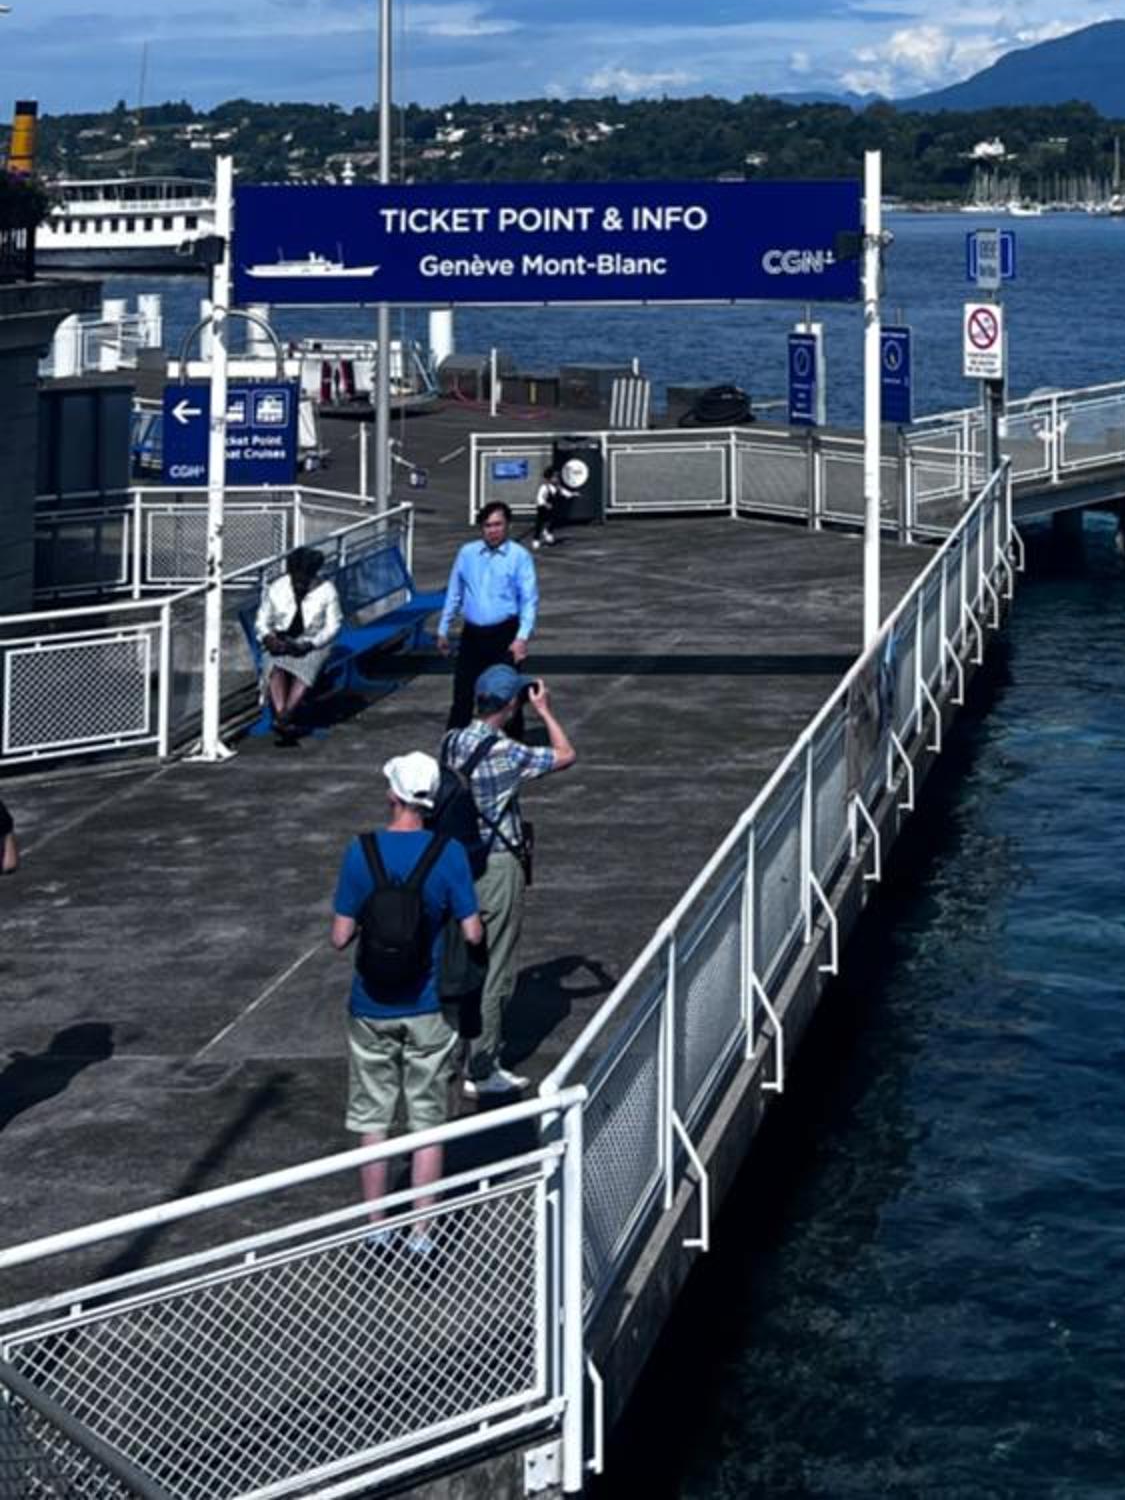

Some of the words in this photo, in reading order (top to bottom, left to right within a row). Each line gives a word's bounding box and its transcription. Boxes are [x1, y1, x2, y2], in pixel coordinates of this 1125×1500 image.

[379, 208, 490, 232] TICKET
[498, 207, 595, 232] POINT
[602, 206, 623, 231] &
[632, 206, 708, 231] INFO
[419, 253, 514, 277] Genève
[522, 252, 667, 276] Mont-Blanc
[762, 249, 824, 275] CGN
[225, 435, 248, 447] cket
[252, 435, 282, 447] Point
[244, 448, 286, 460] Cruises
